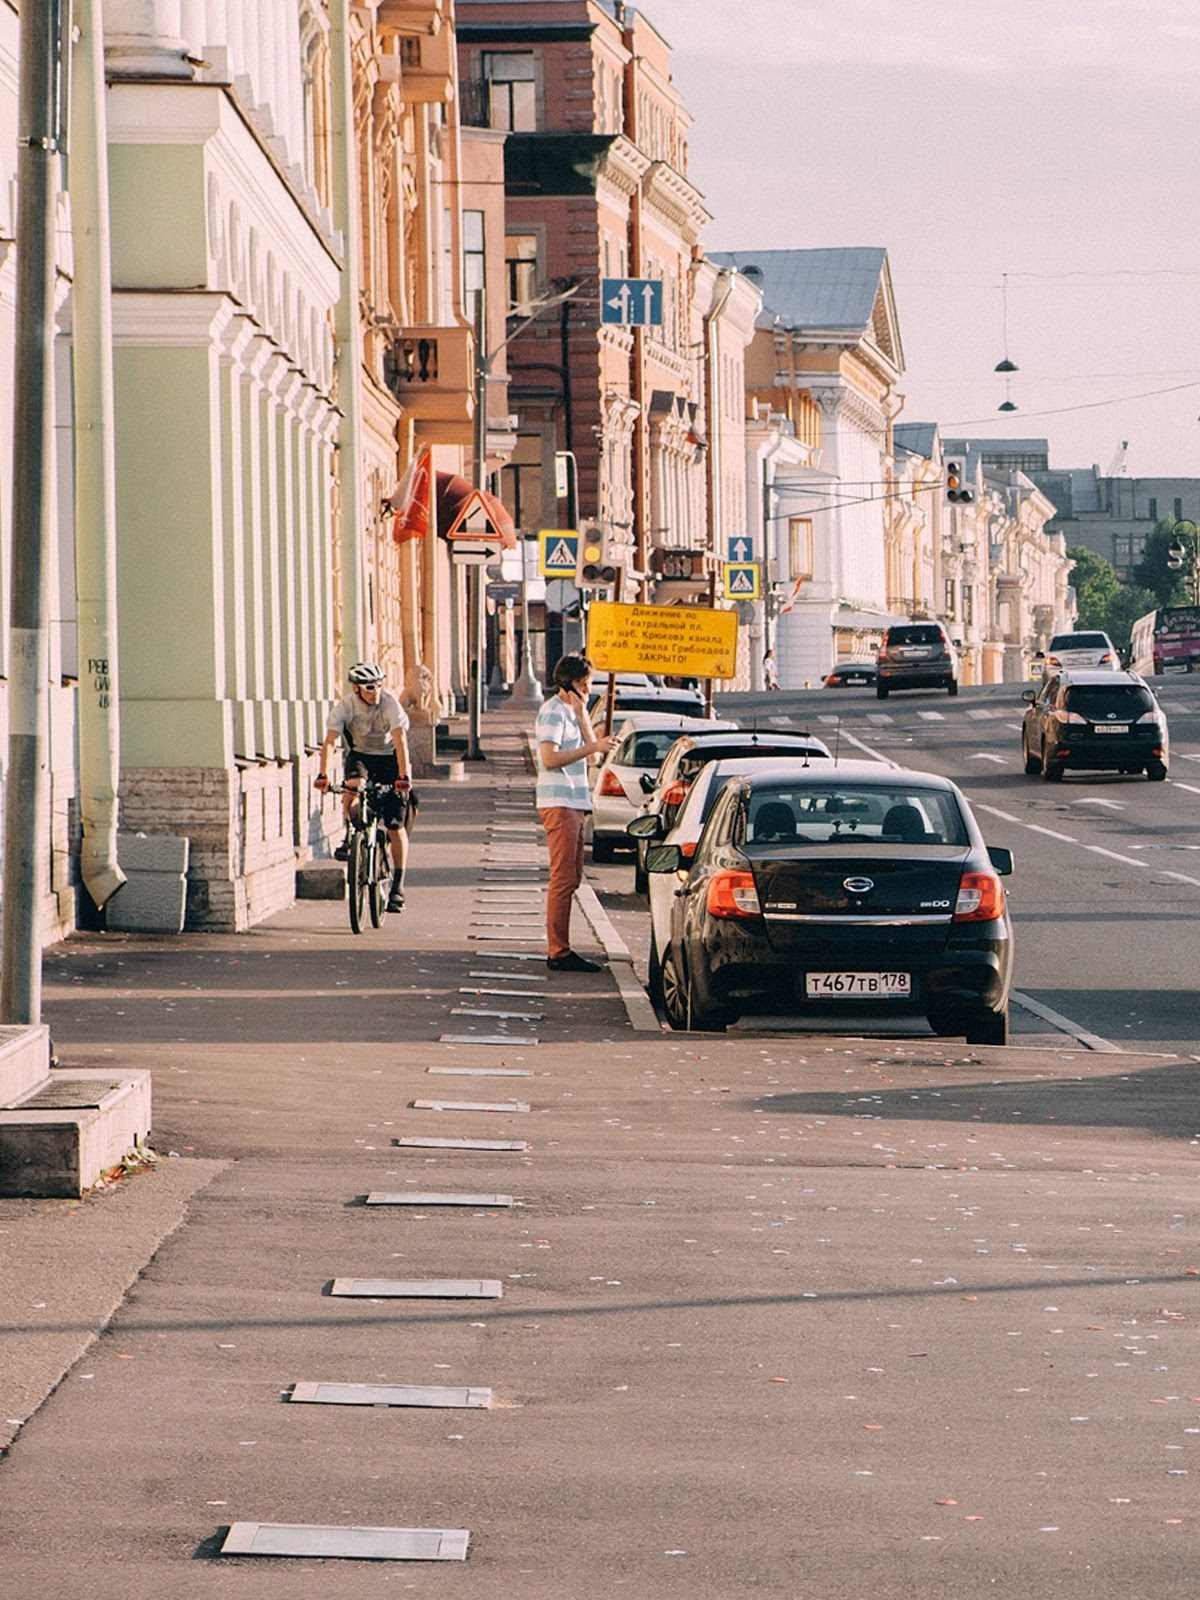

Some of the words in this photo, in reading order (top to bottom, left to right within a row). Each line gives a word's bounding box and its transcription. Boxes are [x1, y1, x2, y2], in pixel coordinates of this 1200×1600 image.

[632, 607, 681, 619] Движение
[625, 618, 686, 630] Театральной
[619, 630, 638, 639] наб.
[642, 631, 684, 641] Крюкова
[689, 635, 722, 644] канала
[595, 640, 607, 648] до
[611, 641, 630, 649] наб.
[635, 643, 668, 651] канала
[672, 644, 730, 655] Грибоедова
[637, 653, 687, 664] ЗАКРЫТО!
[812, 974, 878, 991] Т467ТВ
[881, 974, 907, 987] 178
